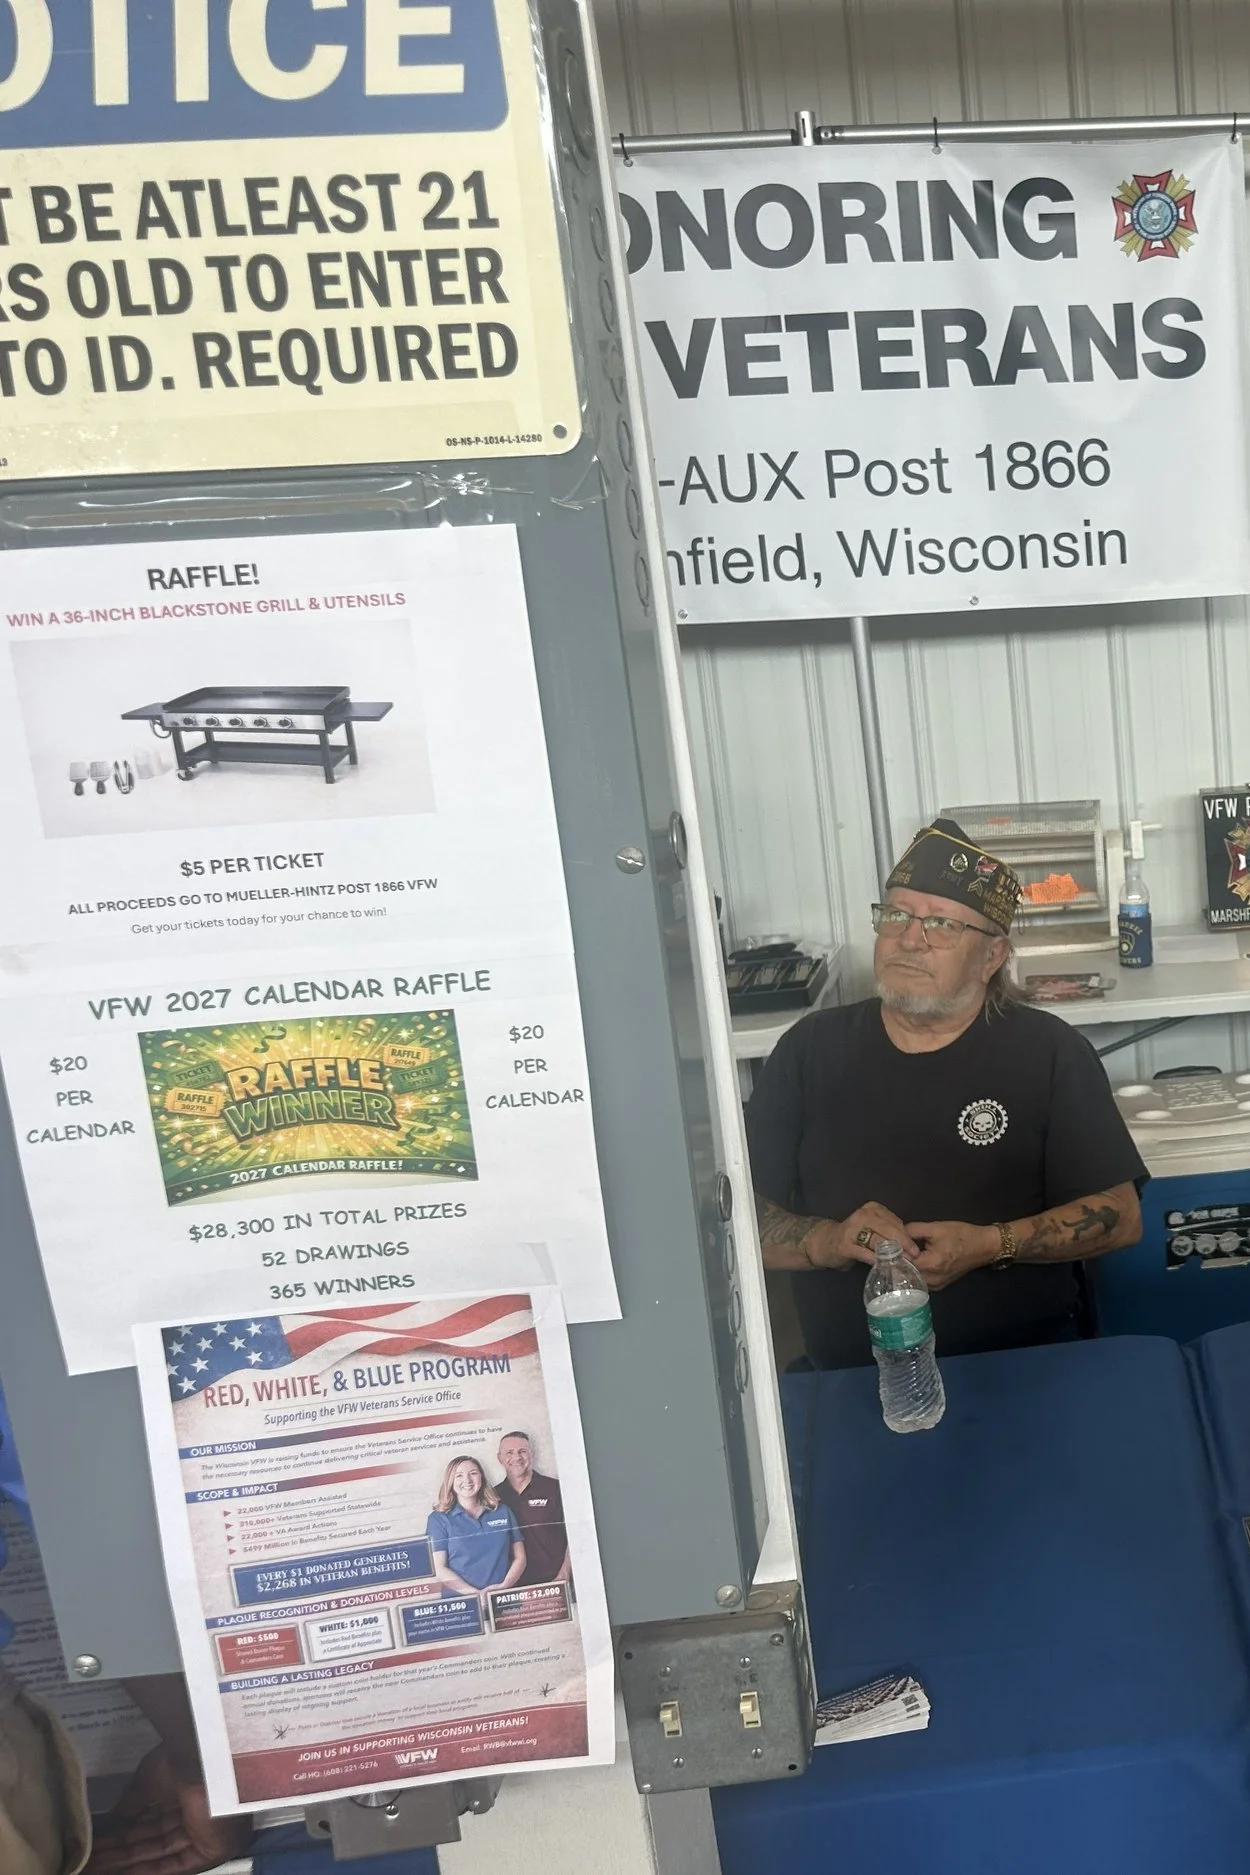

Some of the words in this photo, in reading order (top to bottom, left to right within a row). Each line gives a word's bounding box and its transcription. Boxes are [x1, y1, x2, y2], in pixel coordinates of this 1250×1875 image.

[30, 183, 121, 243] BE
[136, 173, 400, 240] ATLEAST
[418, 170, 499, 230] 21
[66, 257, 193, 318] OLD
[204, 253, 288, 312] TO
[307, 247, 509, 309] ENTER
[85, 335, 174, 392] ID.
[192, 322, 518, 394] REQUIRED
[645, 297, 1207, 399] VETERANS
[825, 445, 953, 499] Post
[975, 437, 1112, 493] 1866
[837, 519, 1129, 579] Wisconsin
[147, 563, 259, 590] RAFFLE!
[6, 613, 43, 626] WIN
[48, 612, 60, 624] A
[63, 607, 135, 624] 36-INCH
[139, 600, 252, 619] BLACKSTONE
[256, 598, 305, 612] GRILL
[308, 597, 320, 610] &
[323, 592, 405, 609] UTENSILS
[1204, 798, 1238, 820] VFW
[180, 860, 204, 877] $5
[210, 857, 251, 874] PER
[253, 852, 324, 871] TICKET
[68, 903, 94, 914] ALL
[96, 896, 176, 912] PROCEEDS
[179, 894, 201, 905] GO
[203, 892, 222, 903] TO
[226, 884, 335, 902] MUELLER-HINTZ
[337, 882, 371, 894] POST
[374, 881, 405, 892] 1866
[406, 878, 437, 890] VFW
[131, 924, 154, 934] Get
[155, 923, 182, 934] your
[183, 919, 224, 929] tickets
[226, 916, 259, 926] today
[261, 914, 277, 923] for
[279, 913, 304, 924] your
[307, 910, 348, 920] chance
[350, 909, 362, 917] to
[363, 907, 386, 916] win!
[88, 995, 152, 1020] VFW
[166, 988, 231, 1012] 2027
[244, 978, 384, 1005] CALENDAR
[393, 969, 491, 996] RAFFLE
[508, 1024, 544, 1042] $20
[49, 1056, 88, 1074] $20
[391, 1048, 422, 1060] RAFFLE
[513, 1058, 548, 1075] PER
[226, 1058, 385, 1101] RAFFLE
[56, 1090, 92, 1107] PER
[177, 1092, 214, 1104] RAFFLE
[224, 1090, 397, 1138] WINNER
[486, 1088, 585, 1110] CALENDAR
[26, 1120, 135, 1144] CALENDAR
[230, 1168, 267, 1184] 2027
[272, 1159, 346, 1178] CALENDAR
[349, 1158, 402, 1172] RAFFLE!
[189, 1217, 274, 1242] $28,300
[283, 1212, 312, 1230] IN
[319, 1208, 387, 1225] TOTAL
[394, 1202, 467, 1221] PRIZES
[261, 1251, 287, 1267] 52
[295, 1241, 409, 1264] DRAWINGS
[270, 1282, 306, 1299] 365
[313, 1274, 415, 1295] WINNERS
[204, 1386, 249, 1408] RED,
[252, 1374, 327, 1401] WHITE,
[333, 1370, 348, 1391] &
[353, 1364, 404, 1389] BLUE
[410, 1354, 512, 1382] PROGRAM
[264, 1409, 317, 1426] Supporting
[319, 1406, 335, 1416] the
[337, 1402, 358, 1414] VFW
[359, 1399, 399, 1410] Veterans
[401, 1394, 433, 1406] Service
[435, 1390, 461, 1402] Office
[189, 1444, 213, 1458] OUR
[214, 1441, 256, 1456] MISSION
[196, 1486, 230, 1502] SCOPE
[231, 1485, 239, 1498] &
[241, 1481, 279, 1497] IMPACT
[256, 1570, 287, 1583] EVERY
[290, 1567, 302, 1578] $1
[305, 1559, 351, 1574] DONATED
[353, 1550, 409, 1566] GENERATES
[256, 1577, 296, 1592] $2,268
[299, 1576, 311, 1586] IN
[313, 1568, 358, 1583] VETERAN
[361, 1560, 410, 1576] BENEFITS!
[218, 1614, 258, 1626] PLAQUE
[260, 1602, 328, 1620] RECOGNITION
[330, 1600, 338, 1609] &
[341, 1591, 393, 1606] DONATION
[395, 1584, 430, 1599] LEVELS
[230, 1673, 279, 1692] BUILDING
[280, 1672, 289, 1685] A
[290, 1665, 332, 1684] LASTING
[334, 1660, 377, 1678] LEGACY
[298, 1751, 321, 1762] JOIN
[324, 1748, 337, 1758] US
[339, 1745, 350, 1755] IN
[353, 1734, 415, 1752] SUPPORTING
[417, 1724, 472, 1741] WISCONSIN
[475, 1716, 528, 1732] VETERANS!
